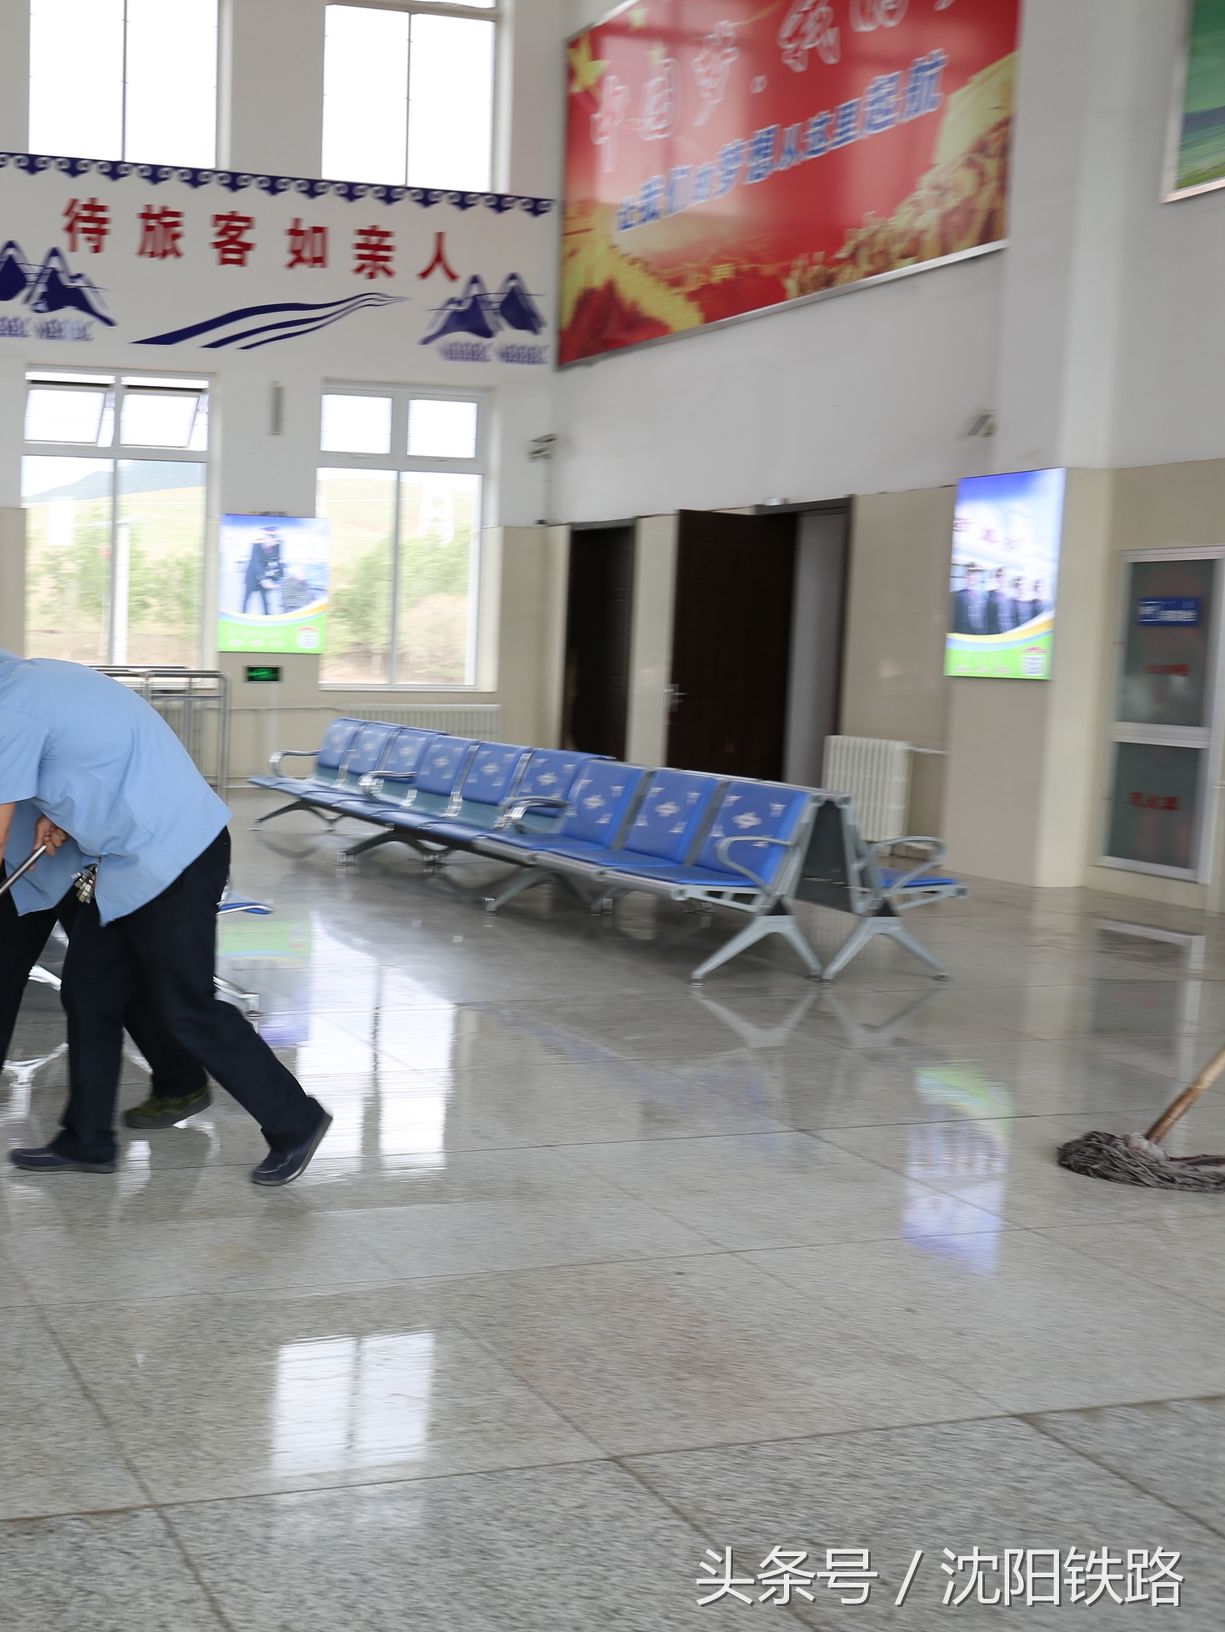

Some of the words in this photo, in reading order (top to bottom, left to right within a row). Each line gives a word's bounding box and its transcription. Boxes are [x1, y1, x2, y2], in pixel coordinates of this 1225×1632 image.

[617, 48, 950, 232] 让我们的梦想从这里起航
[61, 196, 460, 282] 待旅客如亲人
